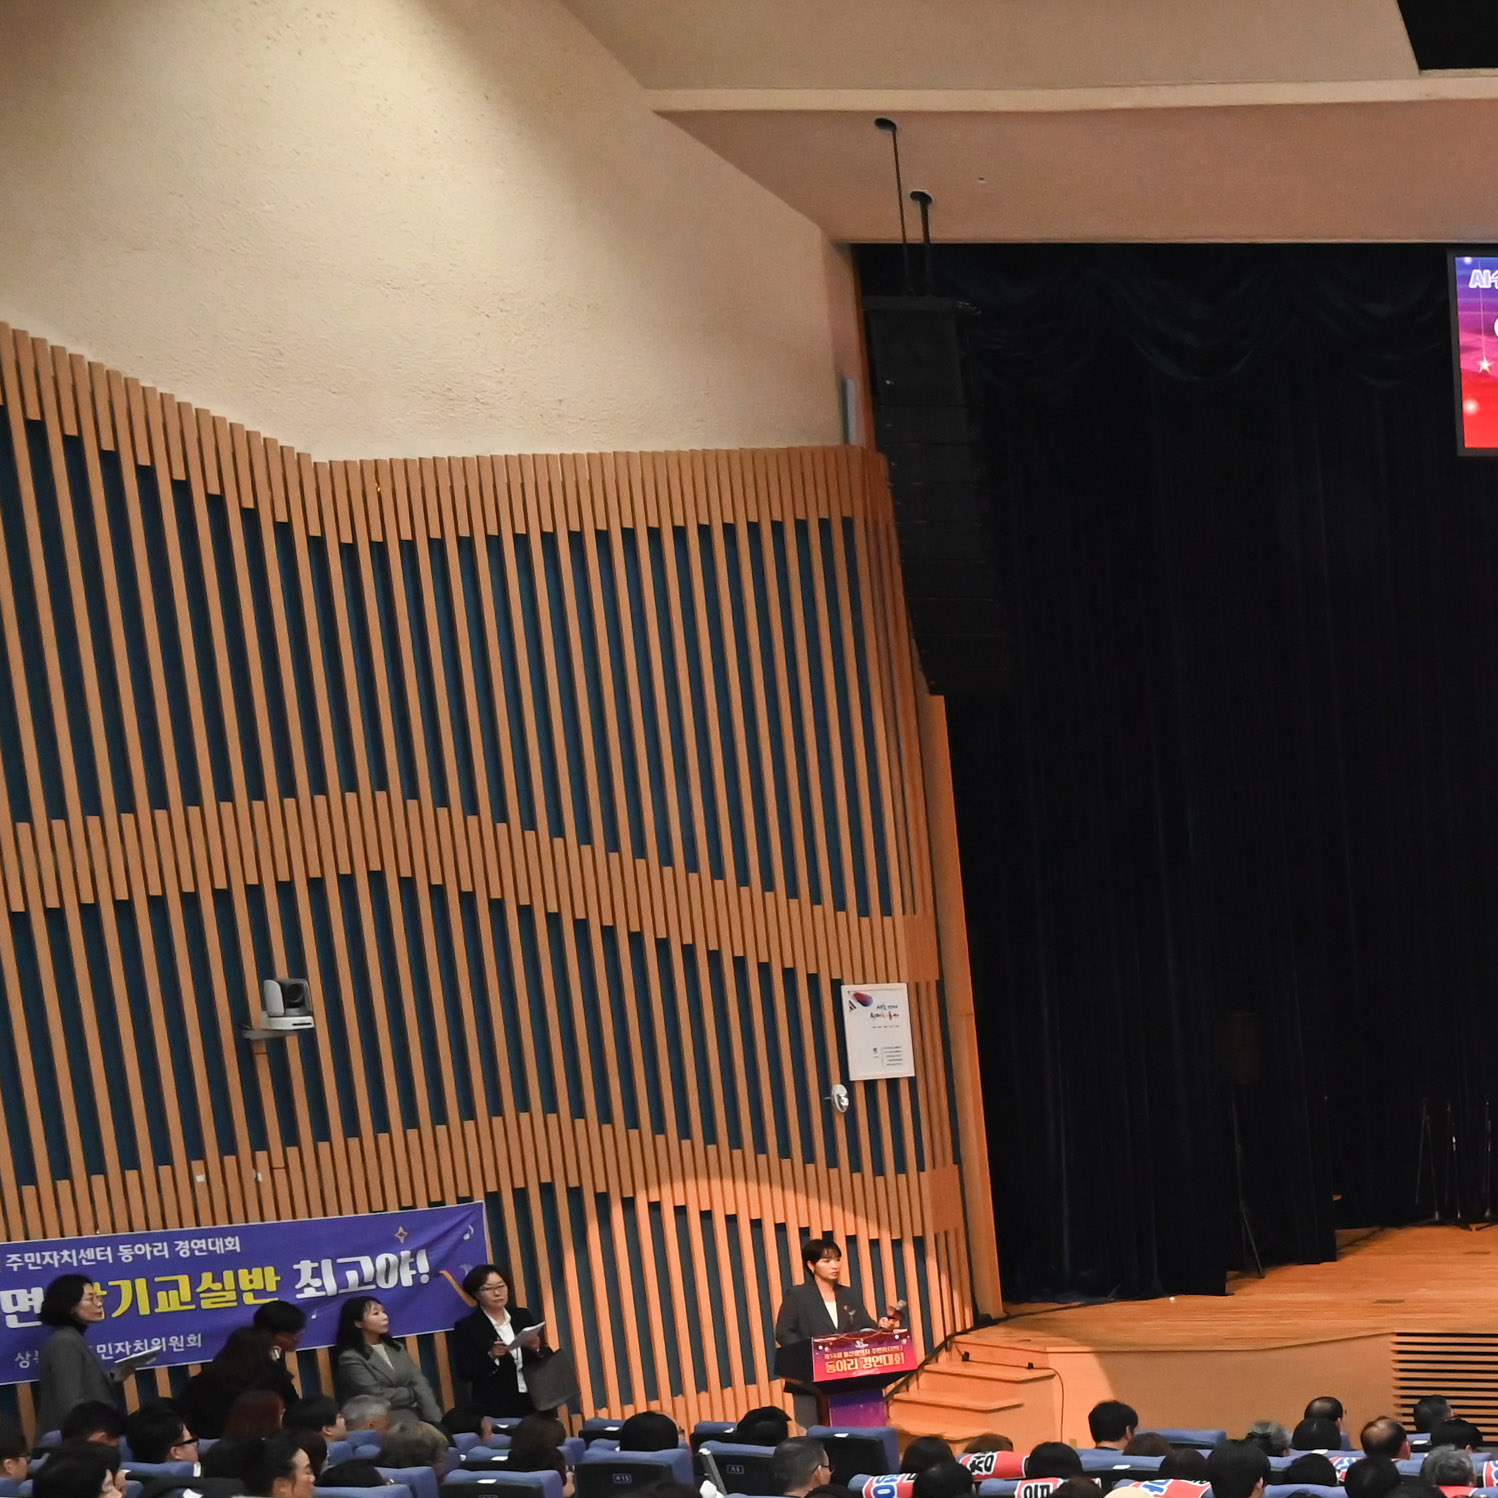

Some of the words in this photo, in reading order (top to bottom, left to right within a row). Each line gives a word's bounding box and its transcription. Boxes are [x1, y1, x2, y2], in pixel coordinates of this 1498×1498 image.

[5, 1246, 113, 1272] 주민자치센터
[117, 1240, 170, 1263] 동아리
[174, 1235, 242, 1259] 경연대회
[95, 1266, 281, 1318] 기교실반
[292, 1248, 431, 1299] 최고야!
[94, 1332, 203, 1361] 민자치위원회
